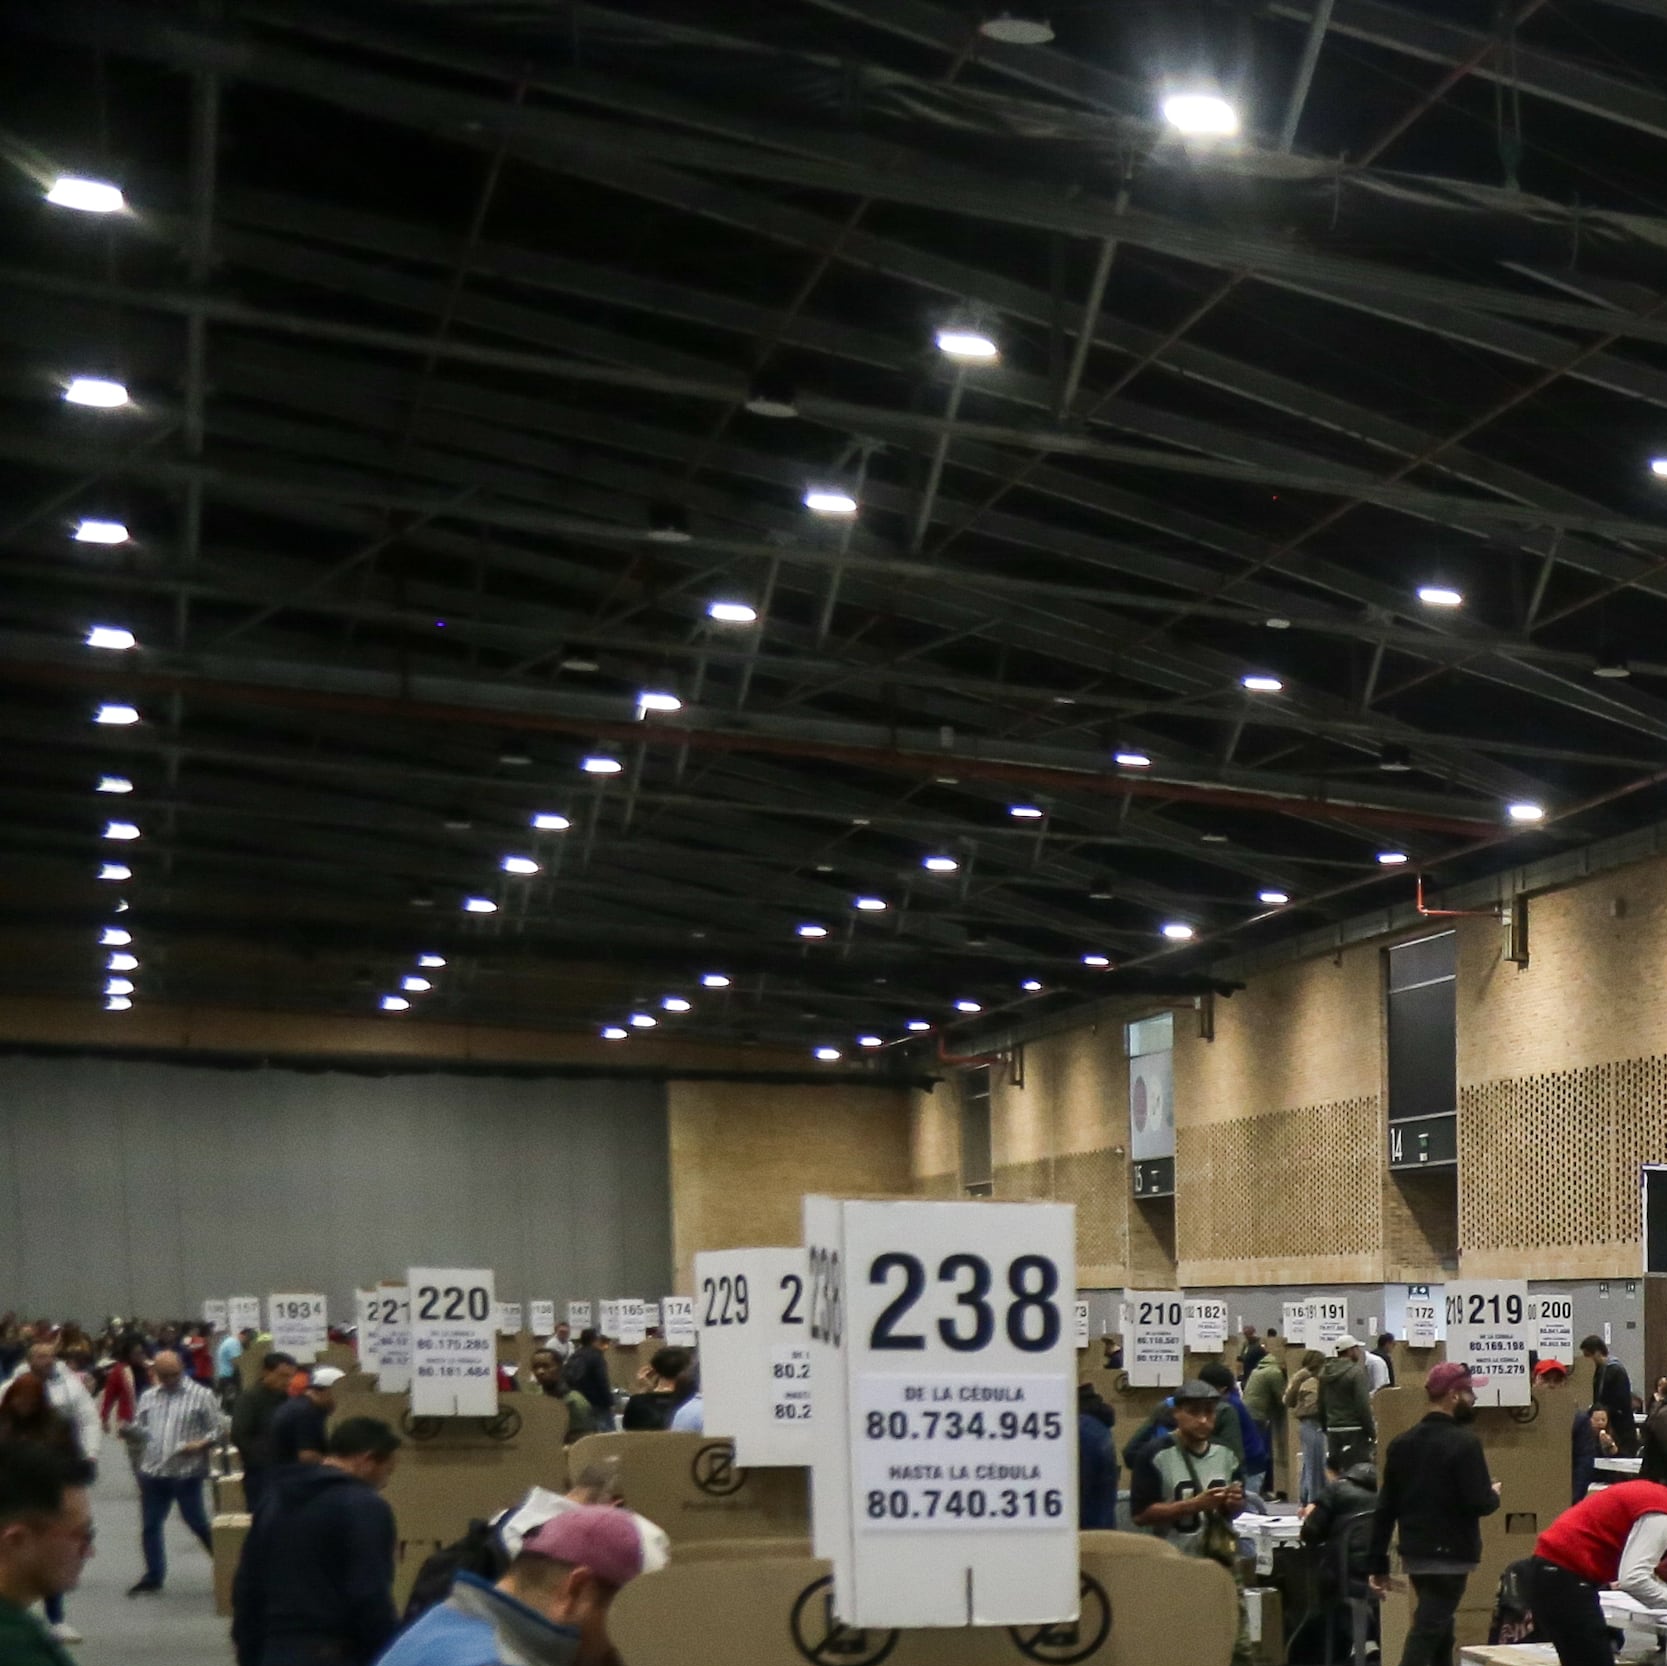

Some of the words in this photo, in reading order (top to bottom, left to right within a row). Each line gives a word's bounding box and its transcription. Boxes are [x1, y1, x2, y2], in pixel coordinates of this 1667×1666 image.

[1391, 1128, 1403, 1162] 14
[418, 1286, 490, 1322] 220
[668, 1303, 693, 1315] 174
[704, 1274, 749, 1326] 229
[868, 1251, 1062, 1352] 238
[276, 1302, 311, 1319] 193
[571, 1306, 589, 1315] 147
[622, 1304, 644, 1315] 165
[1139, 1302, 1182, 1326] 210
[1196, 1306, 1221, 1319] 182
[1320, 1304, 1345, 1319] 191
[1415, 1307, 1435, 1319] 172
[1446, 1295, 1463, 1326] 219
[1468, 1294, 1523, 1325] 219
[1541, 1301, 1571, 1319] 200
[903, 1388, 924, 1401] DE
[932, 1388, 953, 1401] LA
[866, 1411, 1062, 1440] 80.734.945
[889, 1465, 944, 1480] HASTA
[949, 1466, 970, 1480] LA
[867, 1489, 1063, 1519] 80.740.316
